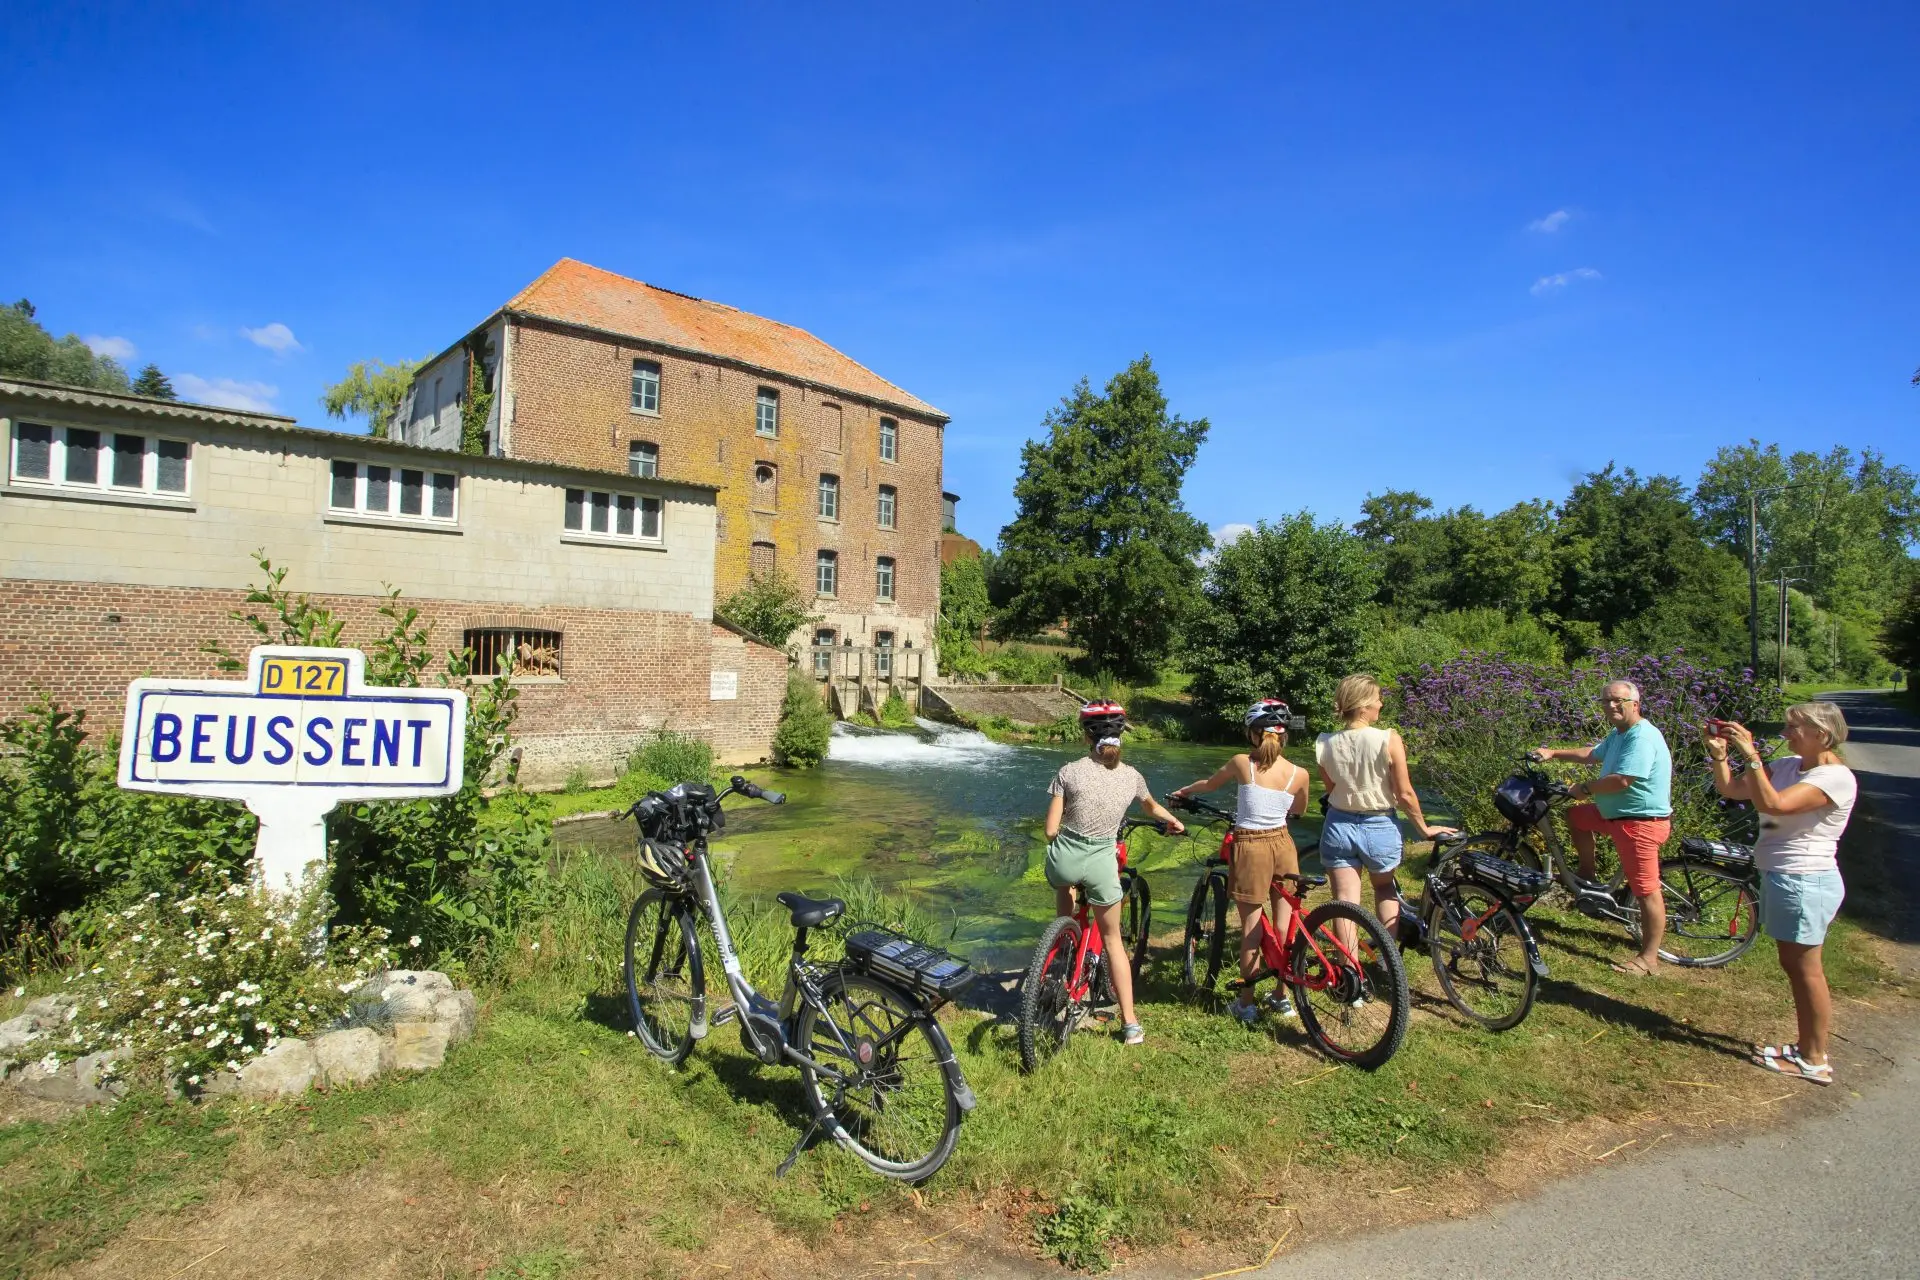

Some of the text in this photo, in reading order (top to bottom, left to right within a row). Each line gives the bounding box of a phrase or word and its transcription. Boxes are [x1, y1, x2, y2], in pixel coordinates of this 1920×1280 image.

[265, 664, 341, 690] D 127
[151, 712, 432, 767] BEUSSENT
